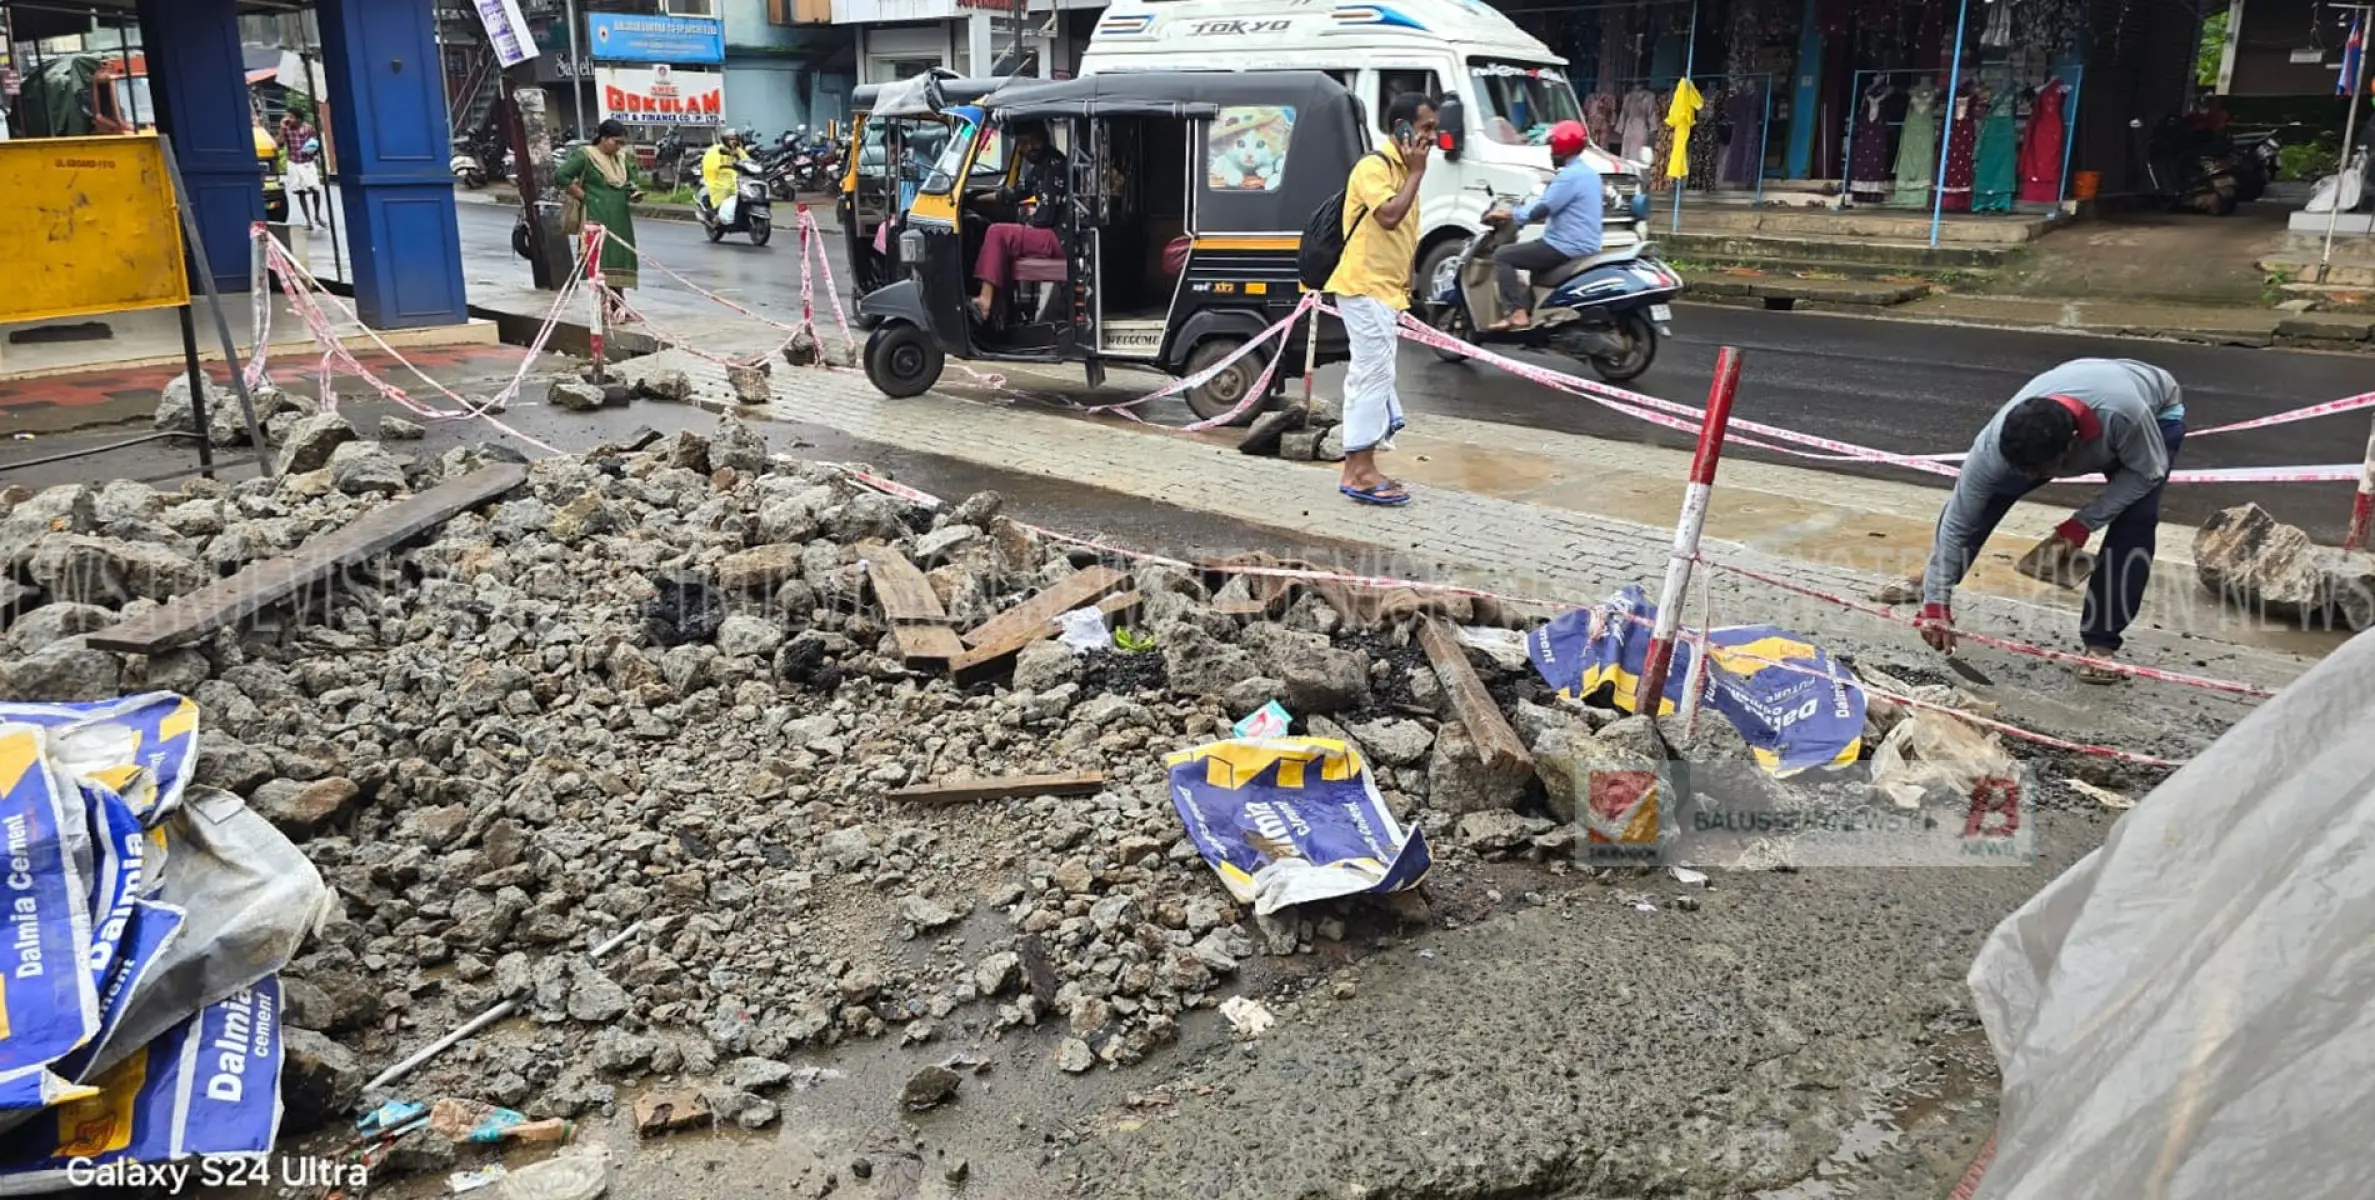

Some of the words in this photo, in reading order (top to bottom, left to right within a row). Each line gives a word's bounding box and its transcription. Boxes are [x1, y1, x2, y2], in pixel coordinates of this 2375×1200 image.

[605, 84, 720, 114] GOKULAM
[6, 812, 34, 892] Cement
[10, 896, 45, 980] Dalmia
[254, 991, 273, 1060] cement
